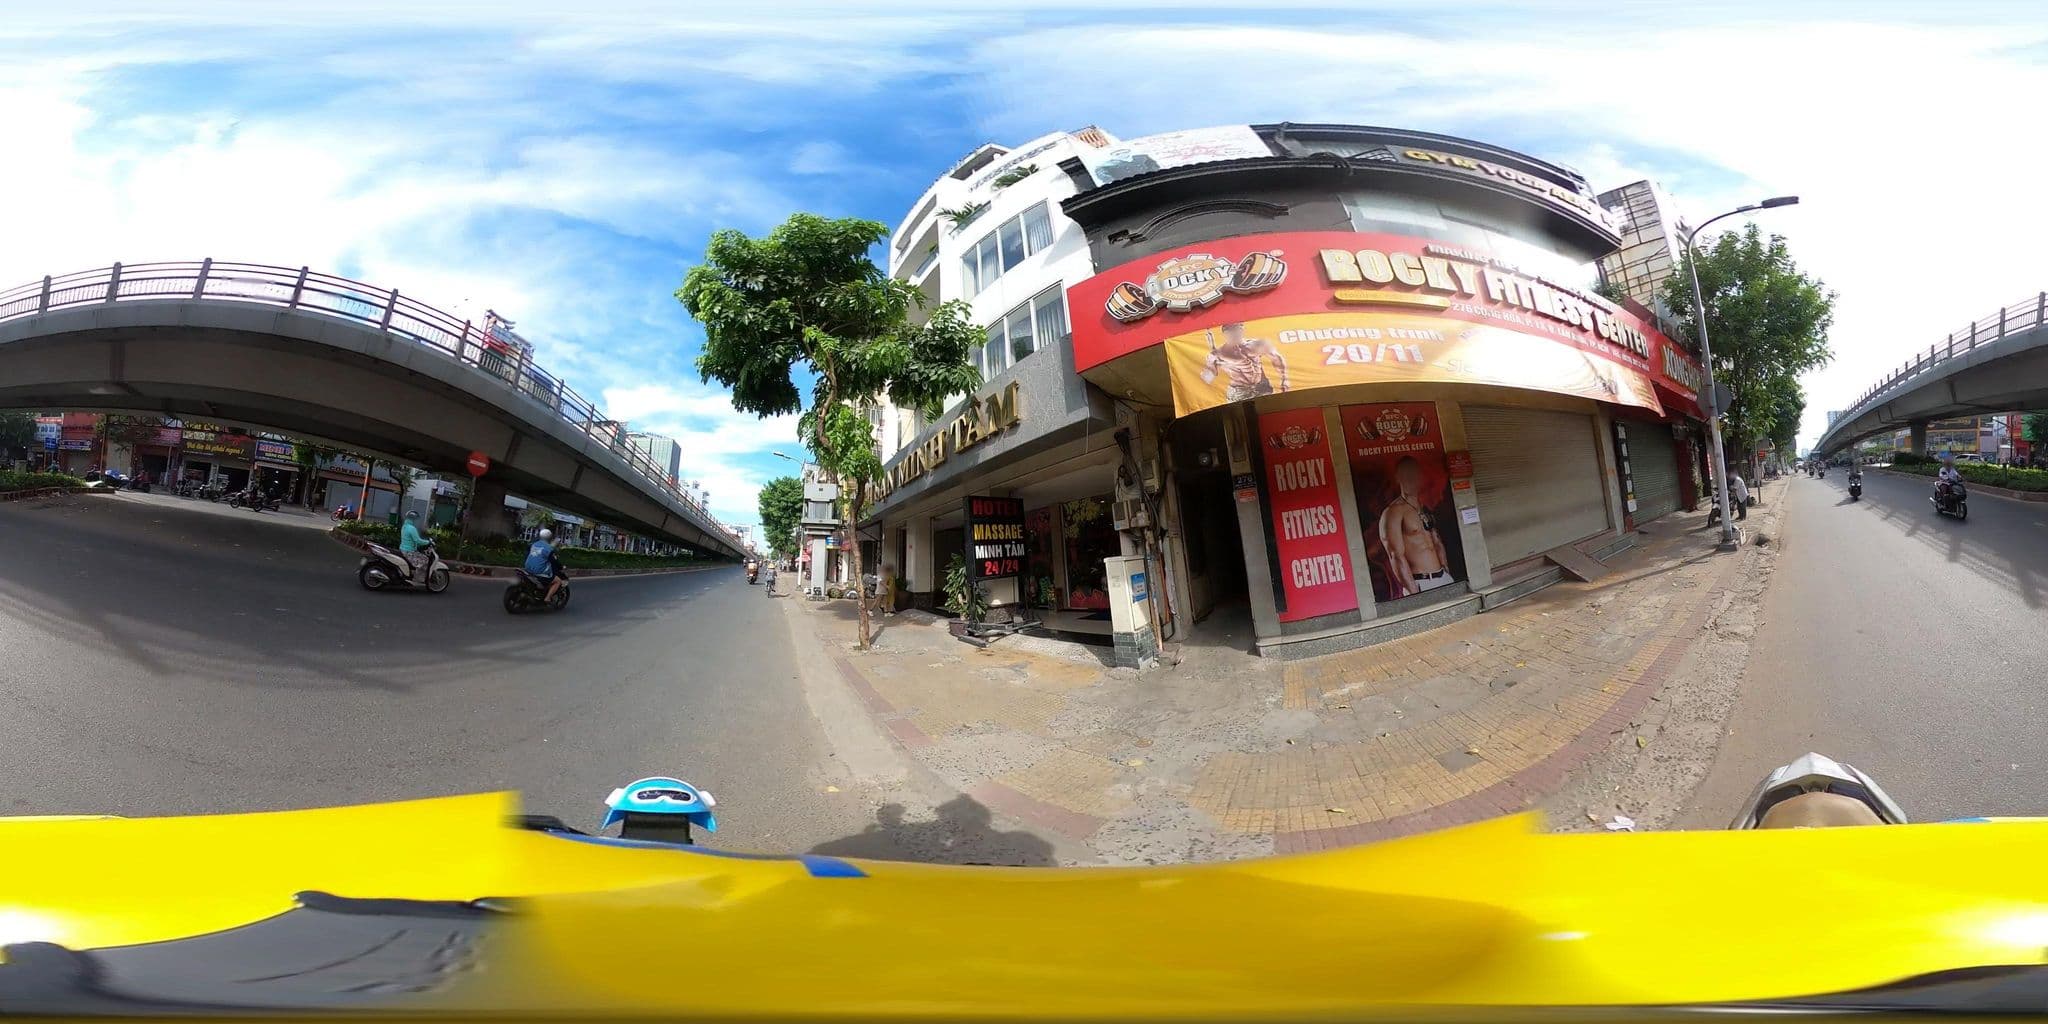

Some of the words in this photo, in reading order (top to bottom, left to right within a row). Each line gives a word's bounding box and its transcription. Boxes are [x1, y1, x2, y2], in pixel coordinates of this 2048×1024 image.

[1404, 150, 1477, 171] GYM
[1479, 162, 1546, 193] YOGA
[1319, 248, 1478, 295] ROCKY
[1482, 267, 1591, 333] FITNESS
[1592, 309, 1650, 360] CENTER
[1280, 327, 1382, 344] Chương
[1322, 343, 1424, 366] 20/11
[899, 428, 947, 488] MINH
[951, 380, 1020, 455] TÂM
[1376, 420, 1410, 430] ROCKY
[1358, 446, 1381, 457] ROCKY
[1383, 444, 1410, 455] FITNESS
[1411, 442, 1435, 451] CENTER
[1274, 458, 1326, 491] ROCKY
[973, 523, 1024, 540] MASSAGE
[1281, 505, 1338, 541] FITNESS
[975, 544, 1003, 559] MINH
[1005, 541, 1025, 557] TÂM
[984, 560, 1019, 576] 24/24
[1291, 553, 1346, 588] CENTER
